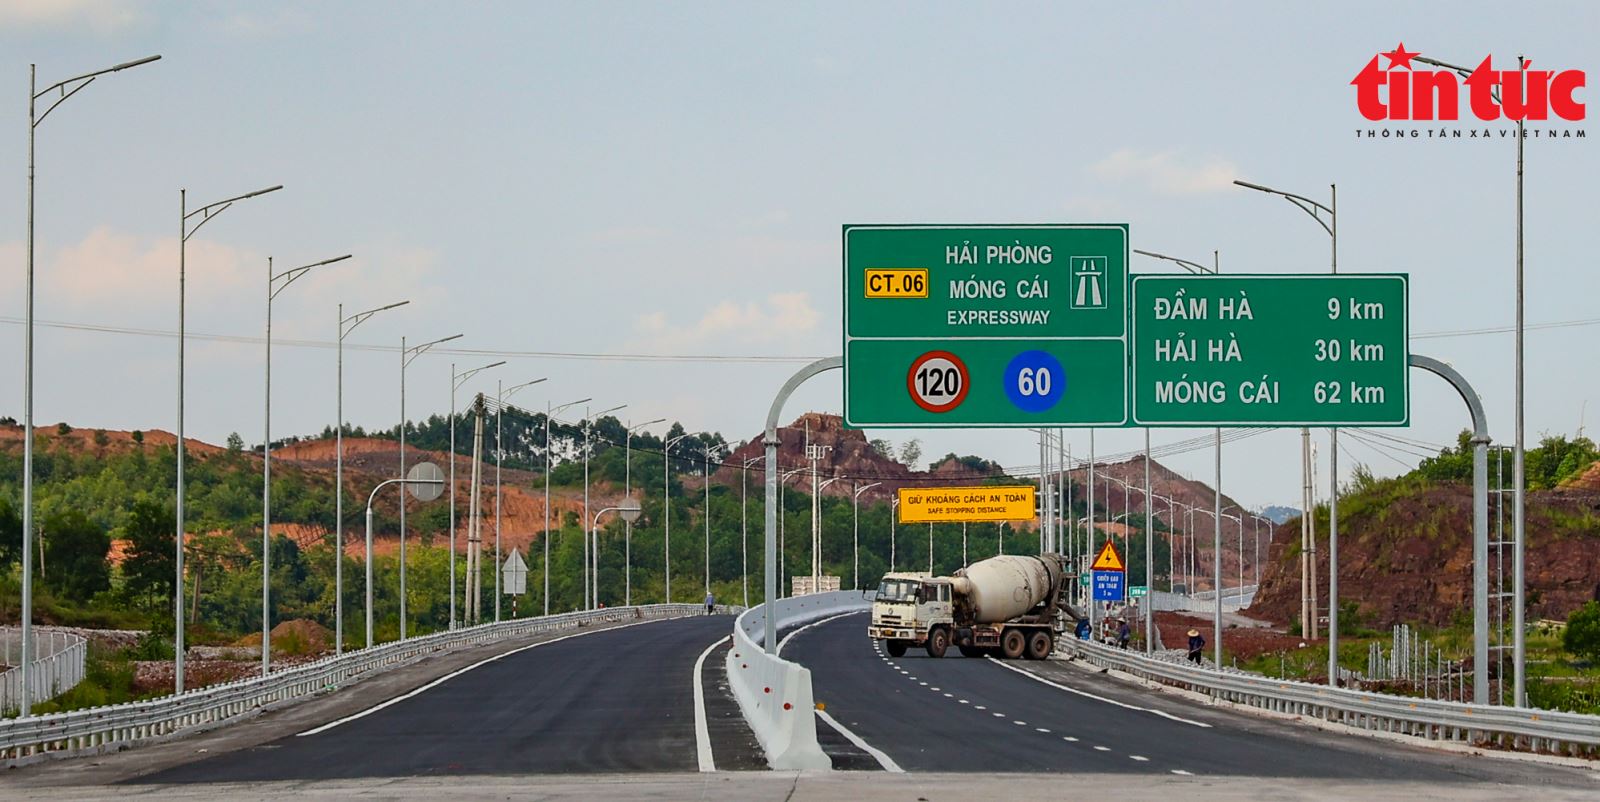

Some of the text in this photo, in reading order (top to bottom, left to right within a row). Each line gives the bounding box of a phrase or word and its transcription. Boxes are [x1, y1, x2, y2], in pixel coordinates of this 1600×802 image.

[946, 240, 1052, 264] HẢI PHÒNG
[869, 274, 924, 293] CT.06
[950, 275, 1049, 299] MÓNG CÁI
[947, 311, 1050, 325] EXPRESSWAY
[1154, 288, 1384, 320] ĐẦM HÀ 9 km
[1155, 332, 1384, 362] HẢI HÀ 30 km
[917, 368, 959, 396] 120
[1018, 367, 1051, 396] 60
[1155, 374, 1385, 404] MÓNG CÁI 62 km
